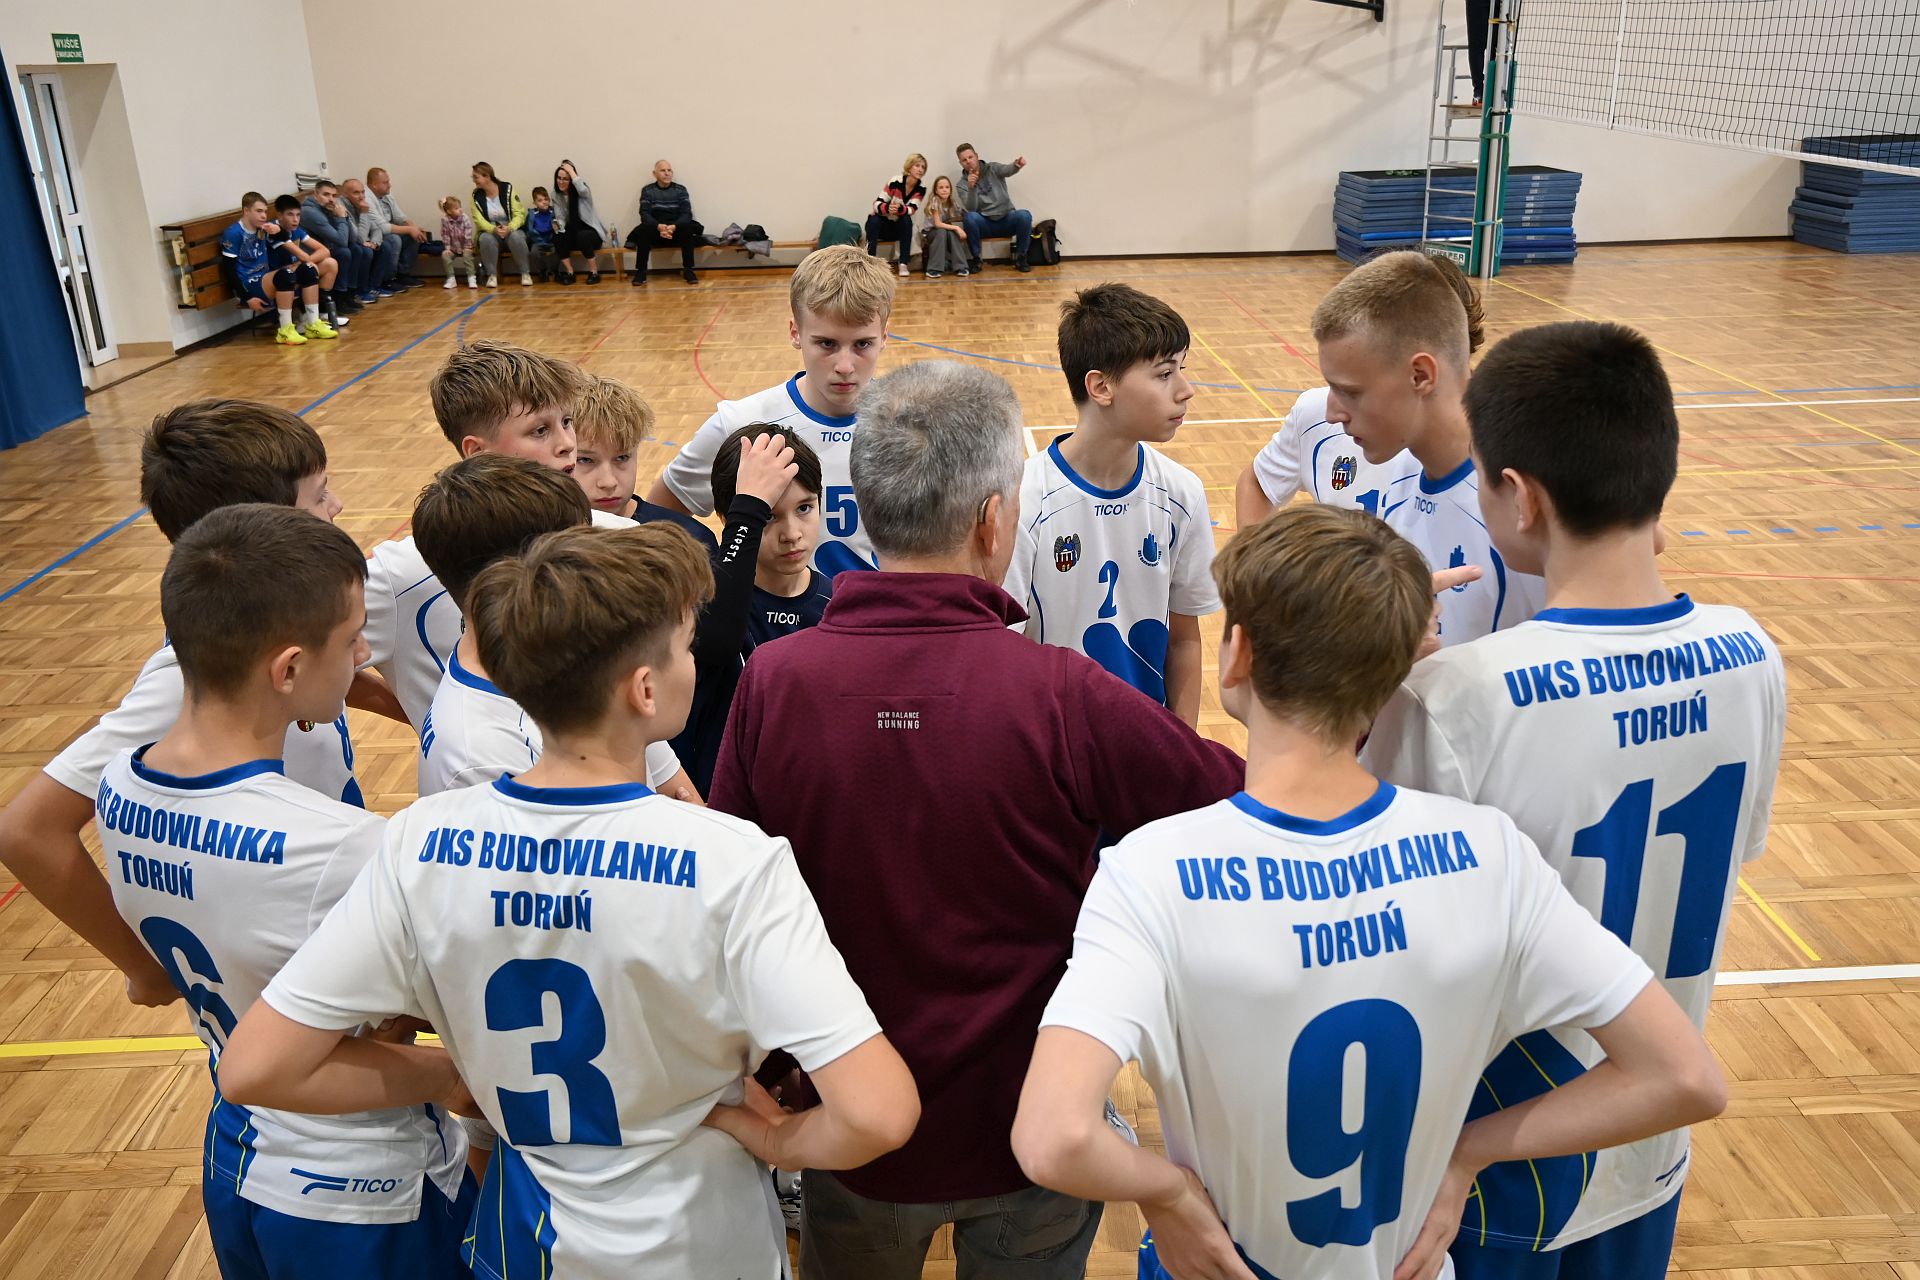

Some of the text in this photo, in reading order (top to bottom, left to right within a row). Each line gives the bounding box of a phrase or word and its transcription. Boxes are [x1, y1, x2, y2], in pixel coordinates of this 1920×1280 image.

[821, 432, 852, 442] TICO
[825, 486, 859, 537] 5
[722, 525, 749, 562] KIPSTA
[1098, 560, 1119, 618] 2
[1504, 631, 1766, 707] UKS BUDOWLANKA
[877, 711, 920, 719] NEW BALANCE
[877, 720, 920, 730] RUNNING
[1613, 690, 1708, 748] TORUŃ
[106, 793, 287, 865] BUDOWLANKA
[418, 827, 697, 888] UKS BUDOWLANKA
[118, 850, 194, 901] TORUŃ
[1176, 830, 1479, 901] UKS BUDOWLANKA
[1571, 761, 1747, 979] 11
[491, 889, 592, 933] TORUŃ
[1292, 900, 1408, 969] TORUŃ
[484, 958, 623, 1146] 3
[1286, 998, 1422, 1247] 9
